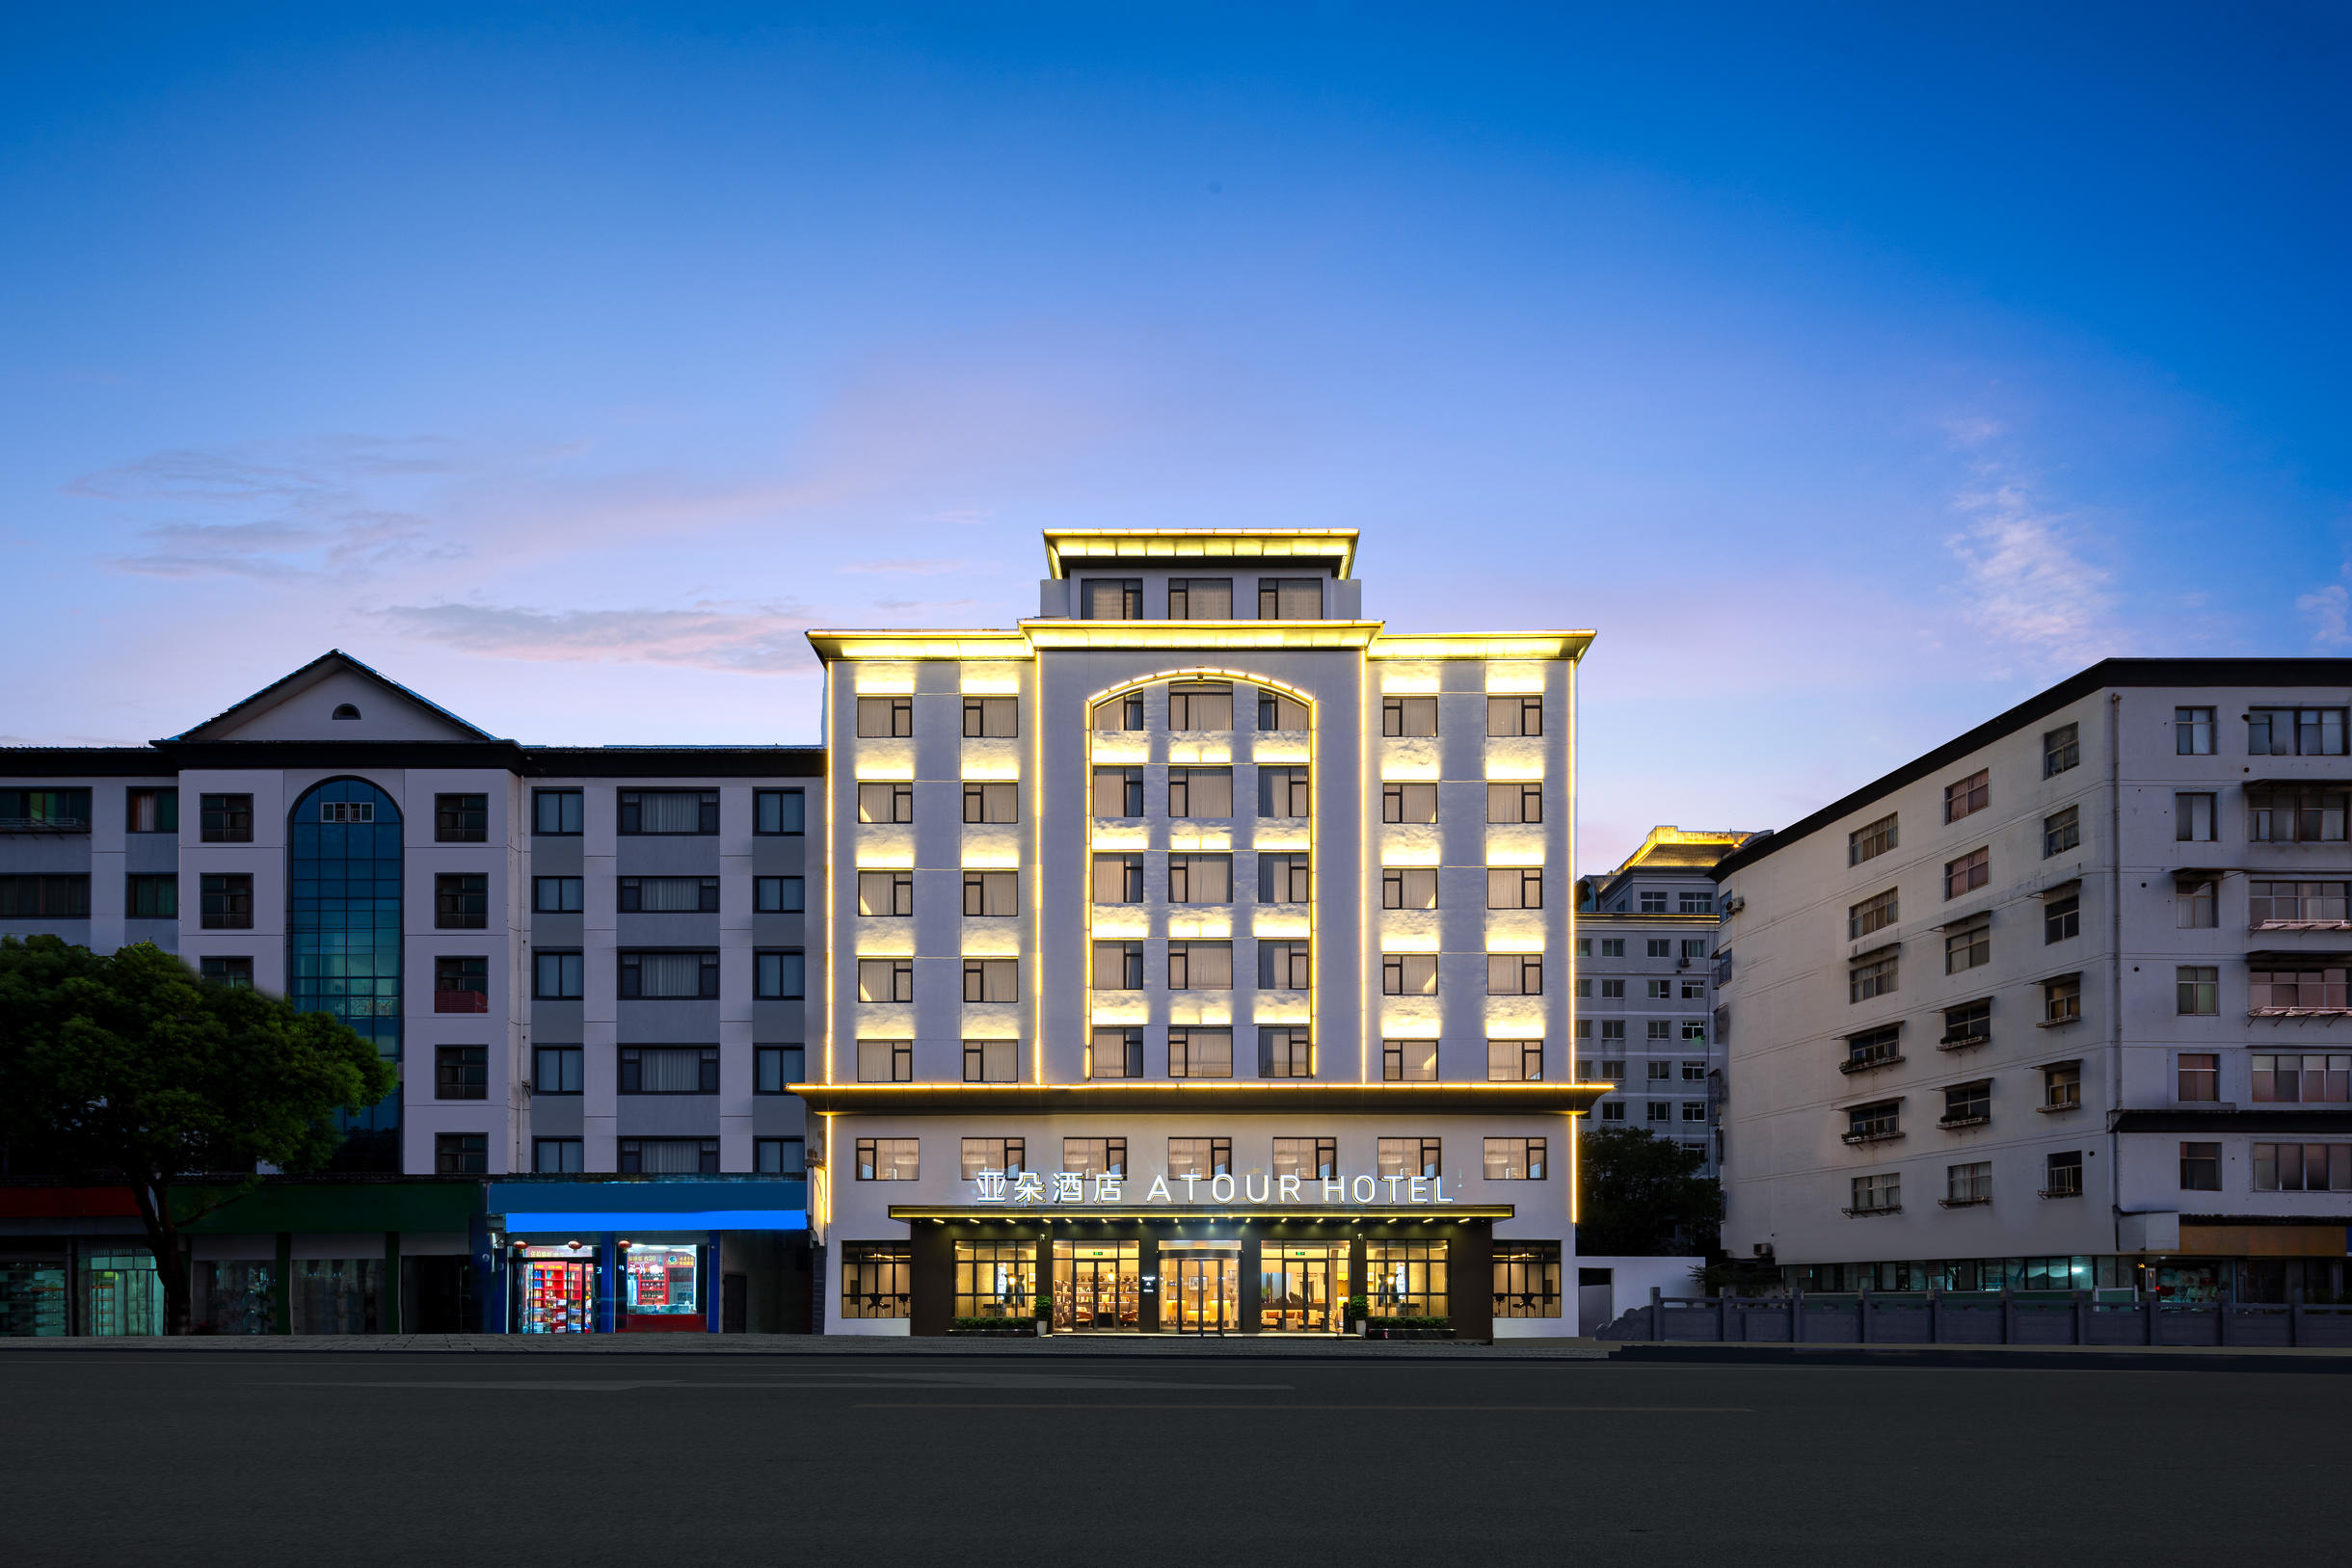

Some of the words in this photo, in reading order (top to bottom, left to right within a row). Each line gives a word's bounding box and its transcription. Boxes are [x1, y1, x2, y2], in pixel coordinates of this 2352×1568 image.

[976, 1170, 1123, 1204] 亚朵酒店
[1146, 1173, 1301, 1204] ATOUR
[1323, 1175, 1455, 1204] HOTEL
